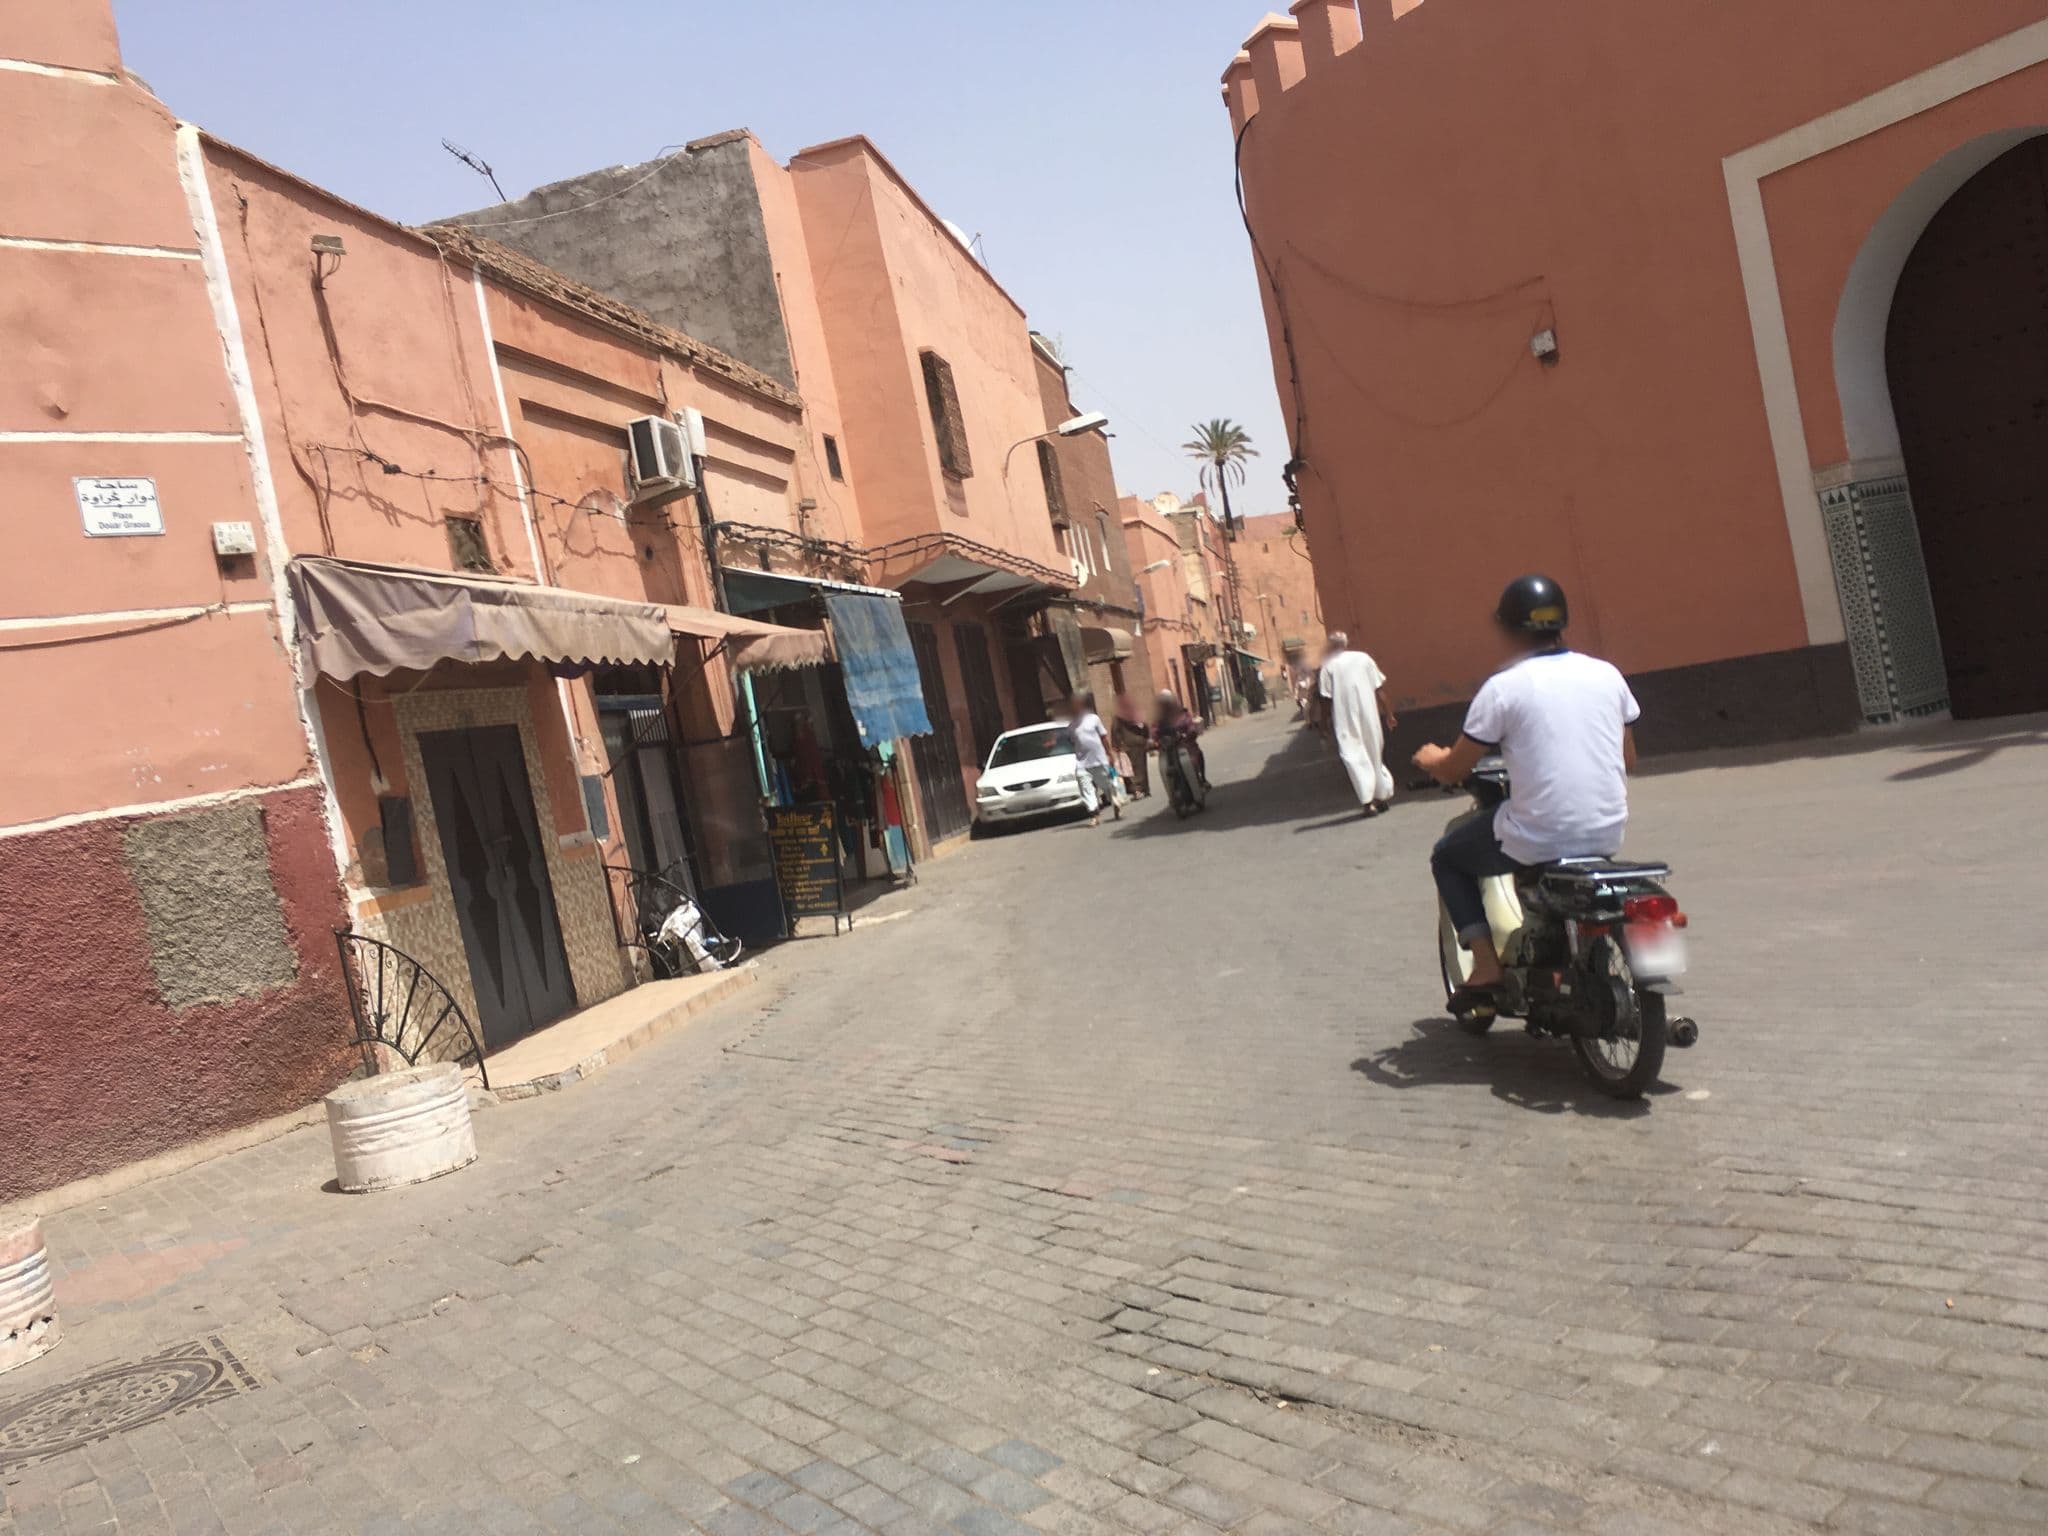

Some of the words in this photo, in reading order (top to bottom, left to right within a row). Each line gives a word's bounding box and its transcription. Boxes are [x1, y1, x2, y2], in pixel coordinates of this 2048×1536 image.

[94, 479, 138, 489] ساحة
[127, 493, 156, 504] دوار
[112, 512, 133, 520] Place
[98, 522, 121, 530] Douar
